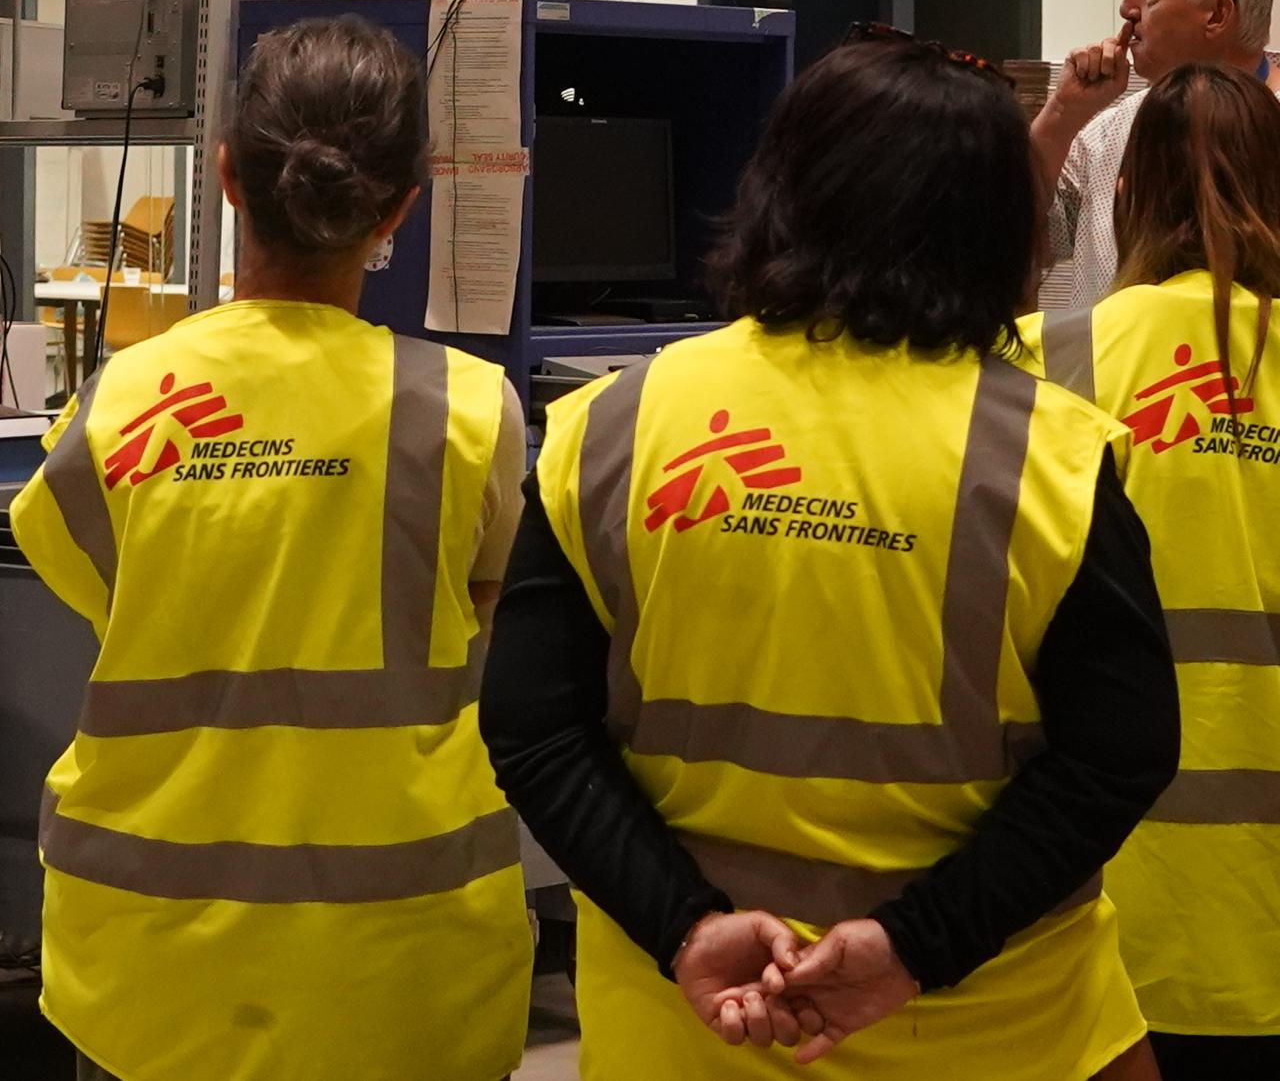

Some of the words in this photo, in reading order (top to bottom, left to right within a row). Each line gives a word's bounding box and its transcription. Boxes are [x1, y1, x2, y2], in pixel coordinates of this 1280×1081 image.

[190, 438, 294, 459] MEDECINS
[173, 462, 227, 482] SANS
[230, 457, 350, 480] FRONTIERES
[742, 492, 858, 519] MEDECINS
[720, 515, 779, 537] SANS
[785, 519, 917, 552] FRONTIERES
